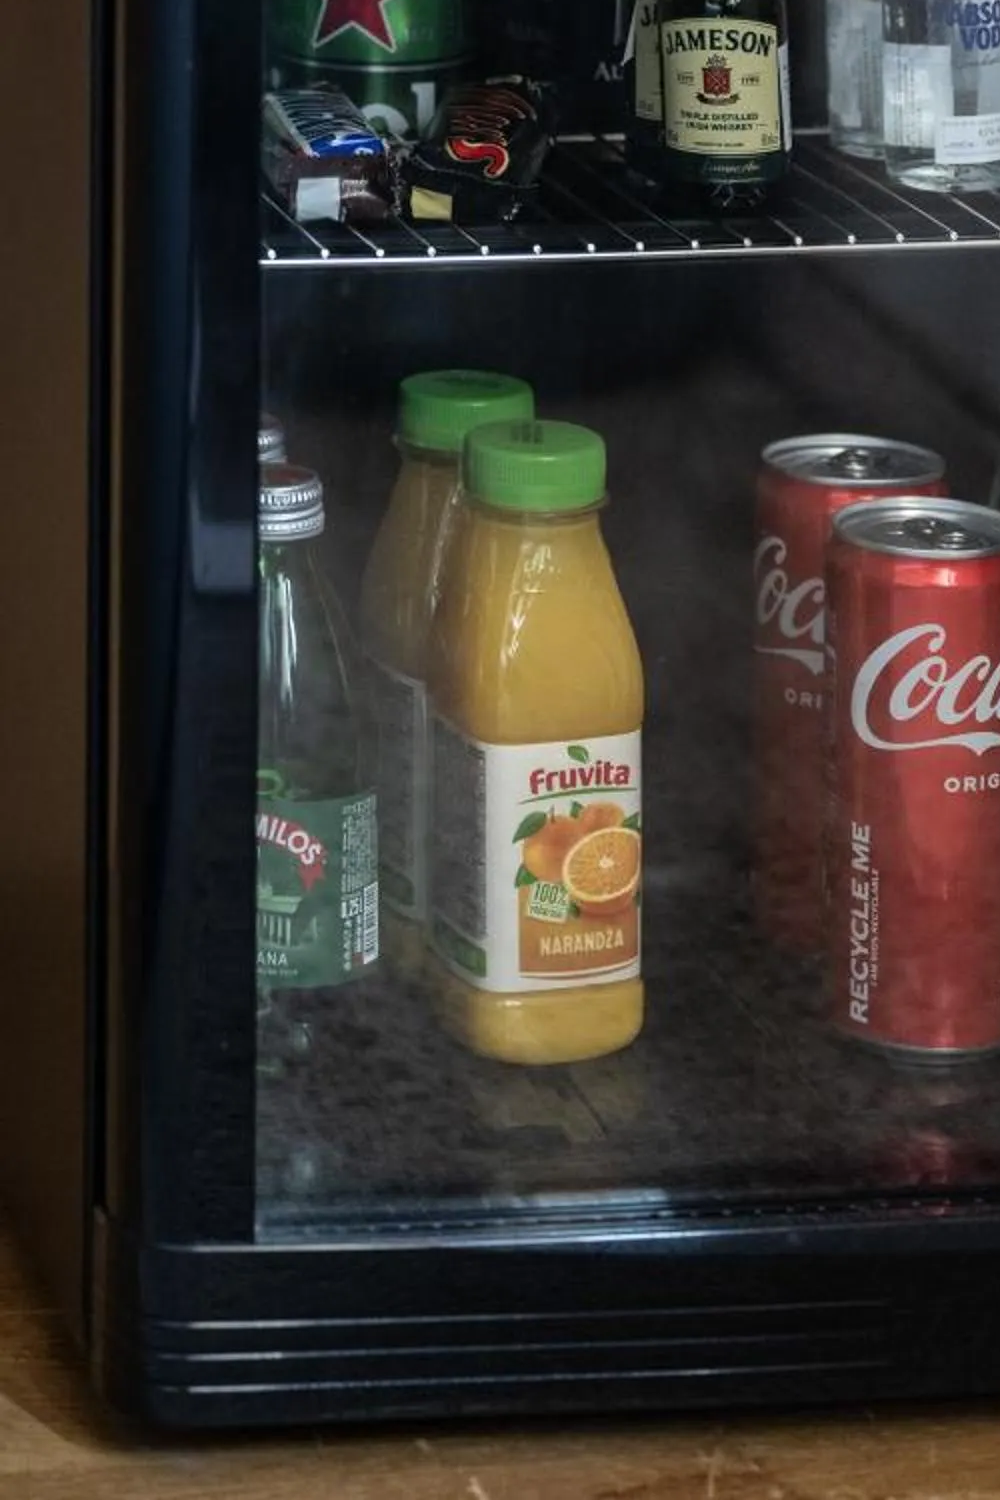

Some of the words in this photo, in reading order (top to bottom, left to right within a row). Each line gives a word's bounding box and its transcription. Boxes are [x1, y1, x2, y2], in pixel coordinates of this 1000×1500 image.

[666, 29, 774, 57] JAMESON
[850, 820, 871, 874] ME
[539, 927, 625, 956] NARANDŽA
[849, 877, 870, 1025] RECYCLE
